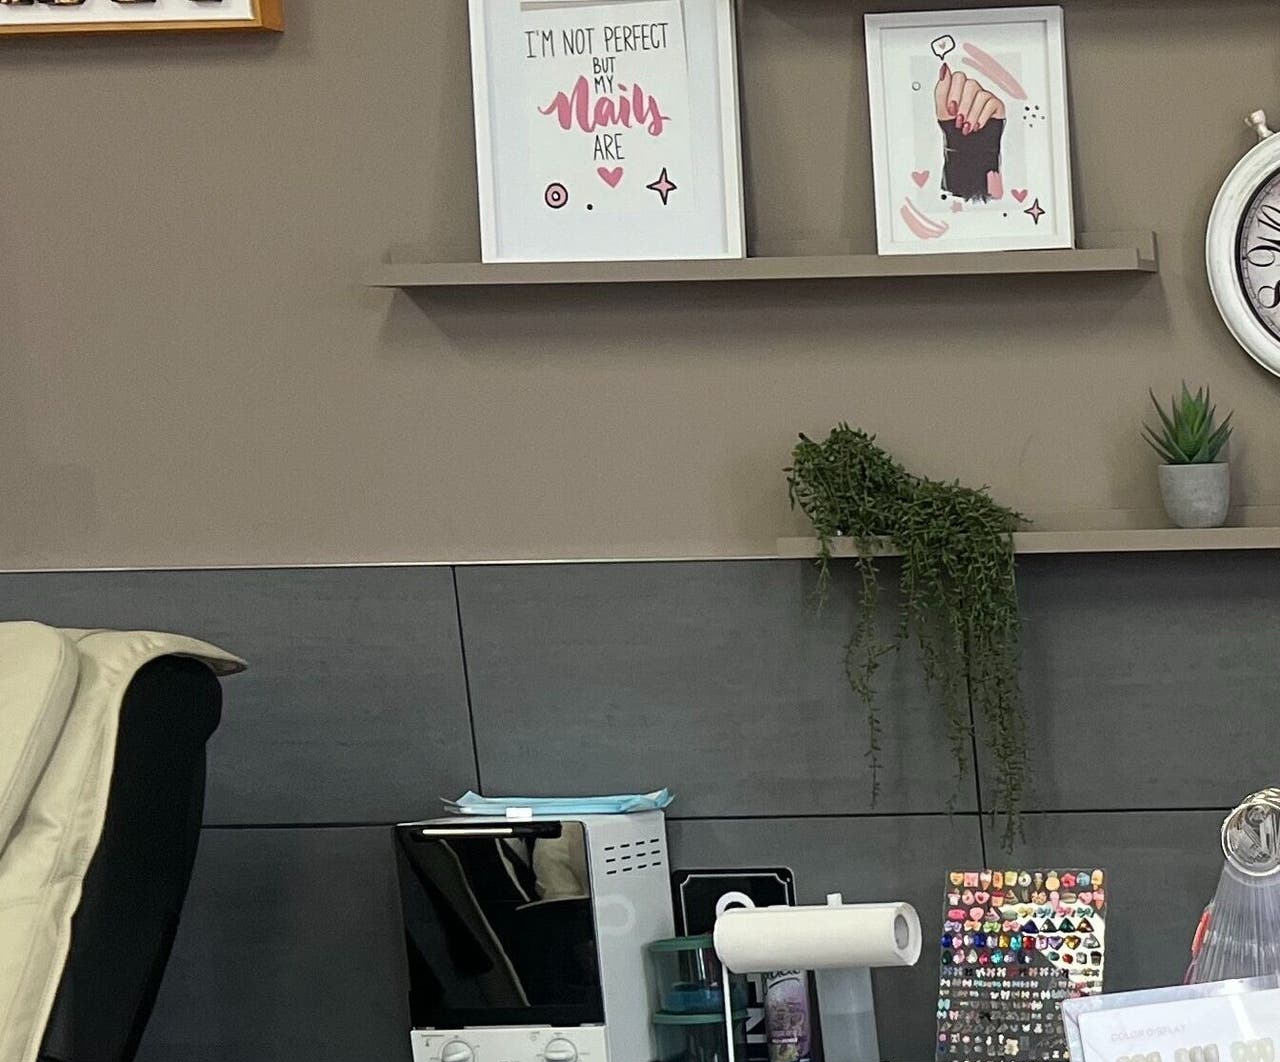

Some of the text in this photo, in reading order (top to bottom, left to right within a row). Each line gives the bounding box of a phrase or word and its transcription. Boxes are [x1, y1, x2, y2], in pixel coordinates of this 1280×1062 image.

[524, 22, 669, 58] I'M NOT PERFECT
[592, 56, 616, 75] BUT
[594, 75, 614, 94] MY
[537, 75, 672, 136] Nails
[593, 133, 625, 161] ARE
